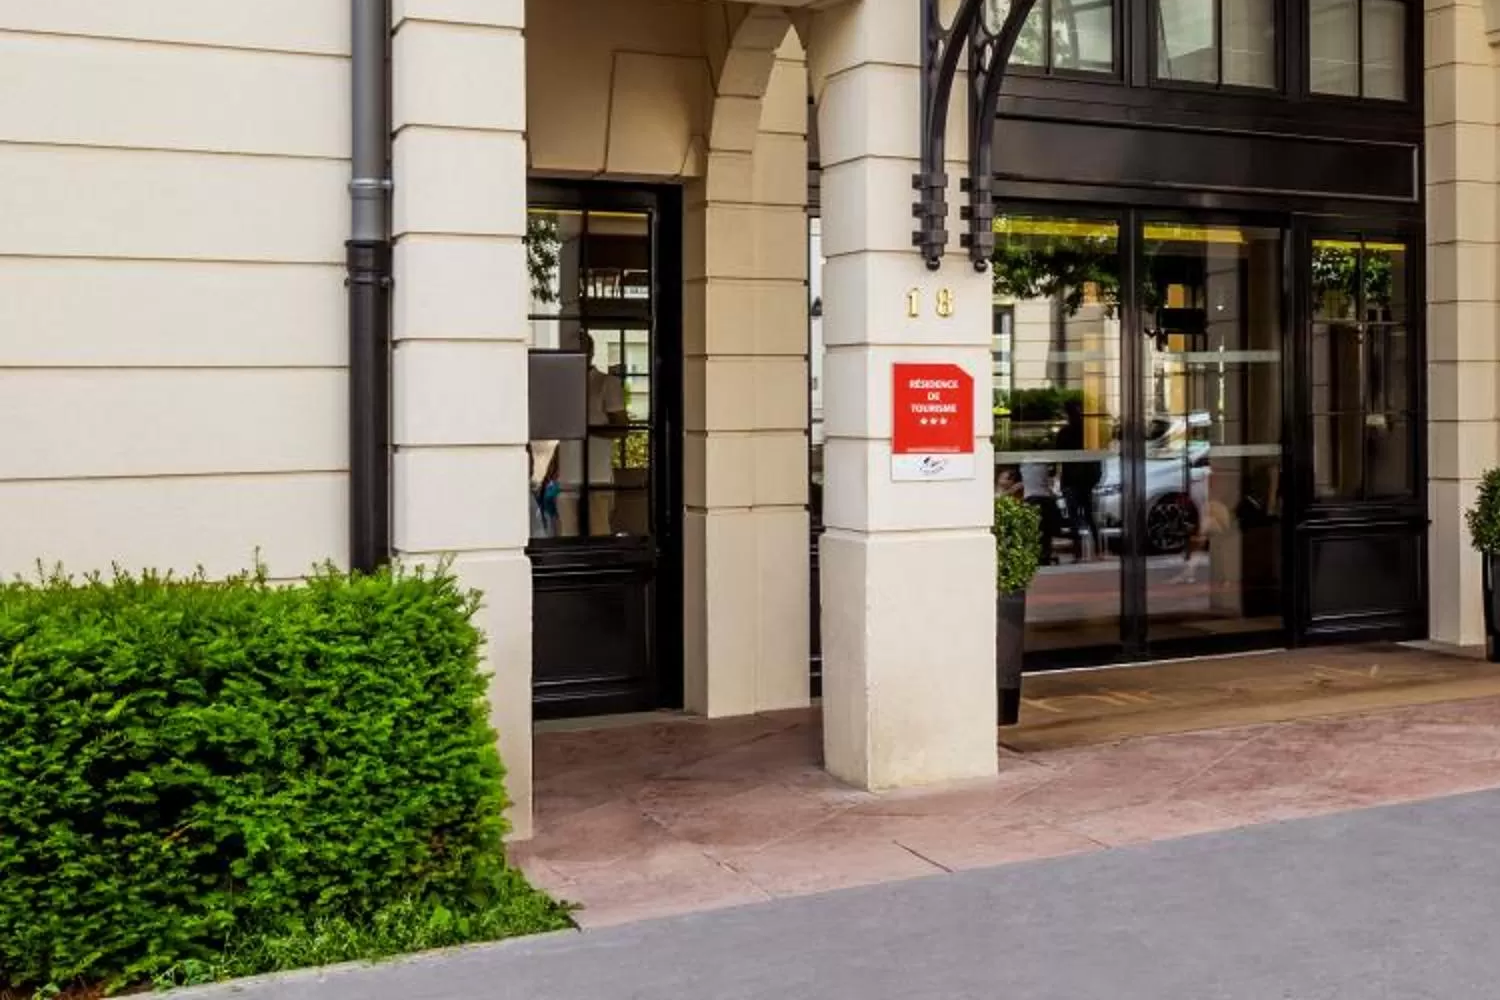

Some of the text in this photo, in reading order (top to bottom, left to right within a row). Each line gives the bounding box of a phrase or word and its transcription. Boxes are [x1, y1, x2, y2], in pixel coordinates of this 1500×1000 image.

[906, 287, 953, 317] 18
[927, 391, 941, 401] DE
[911, 403, 958, 413] TOURISME
